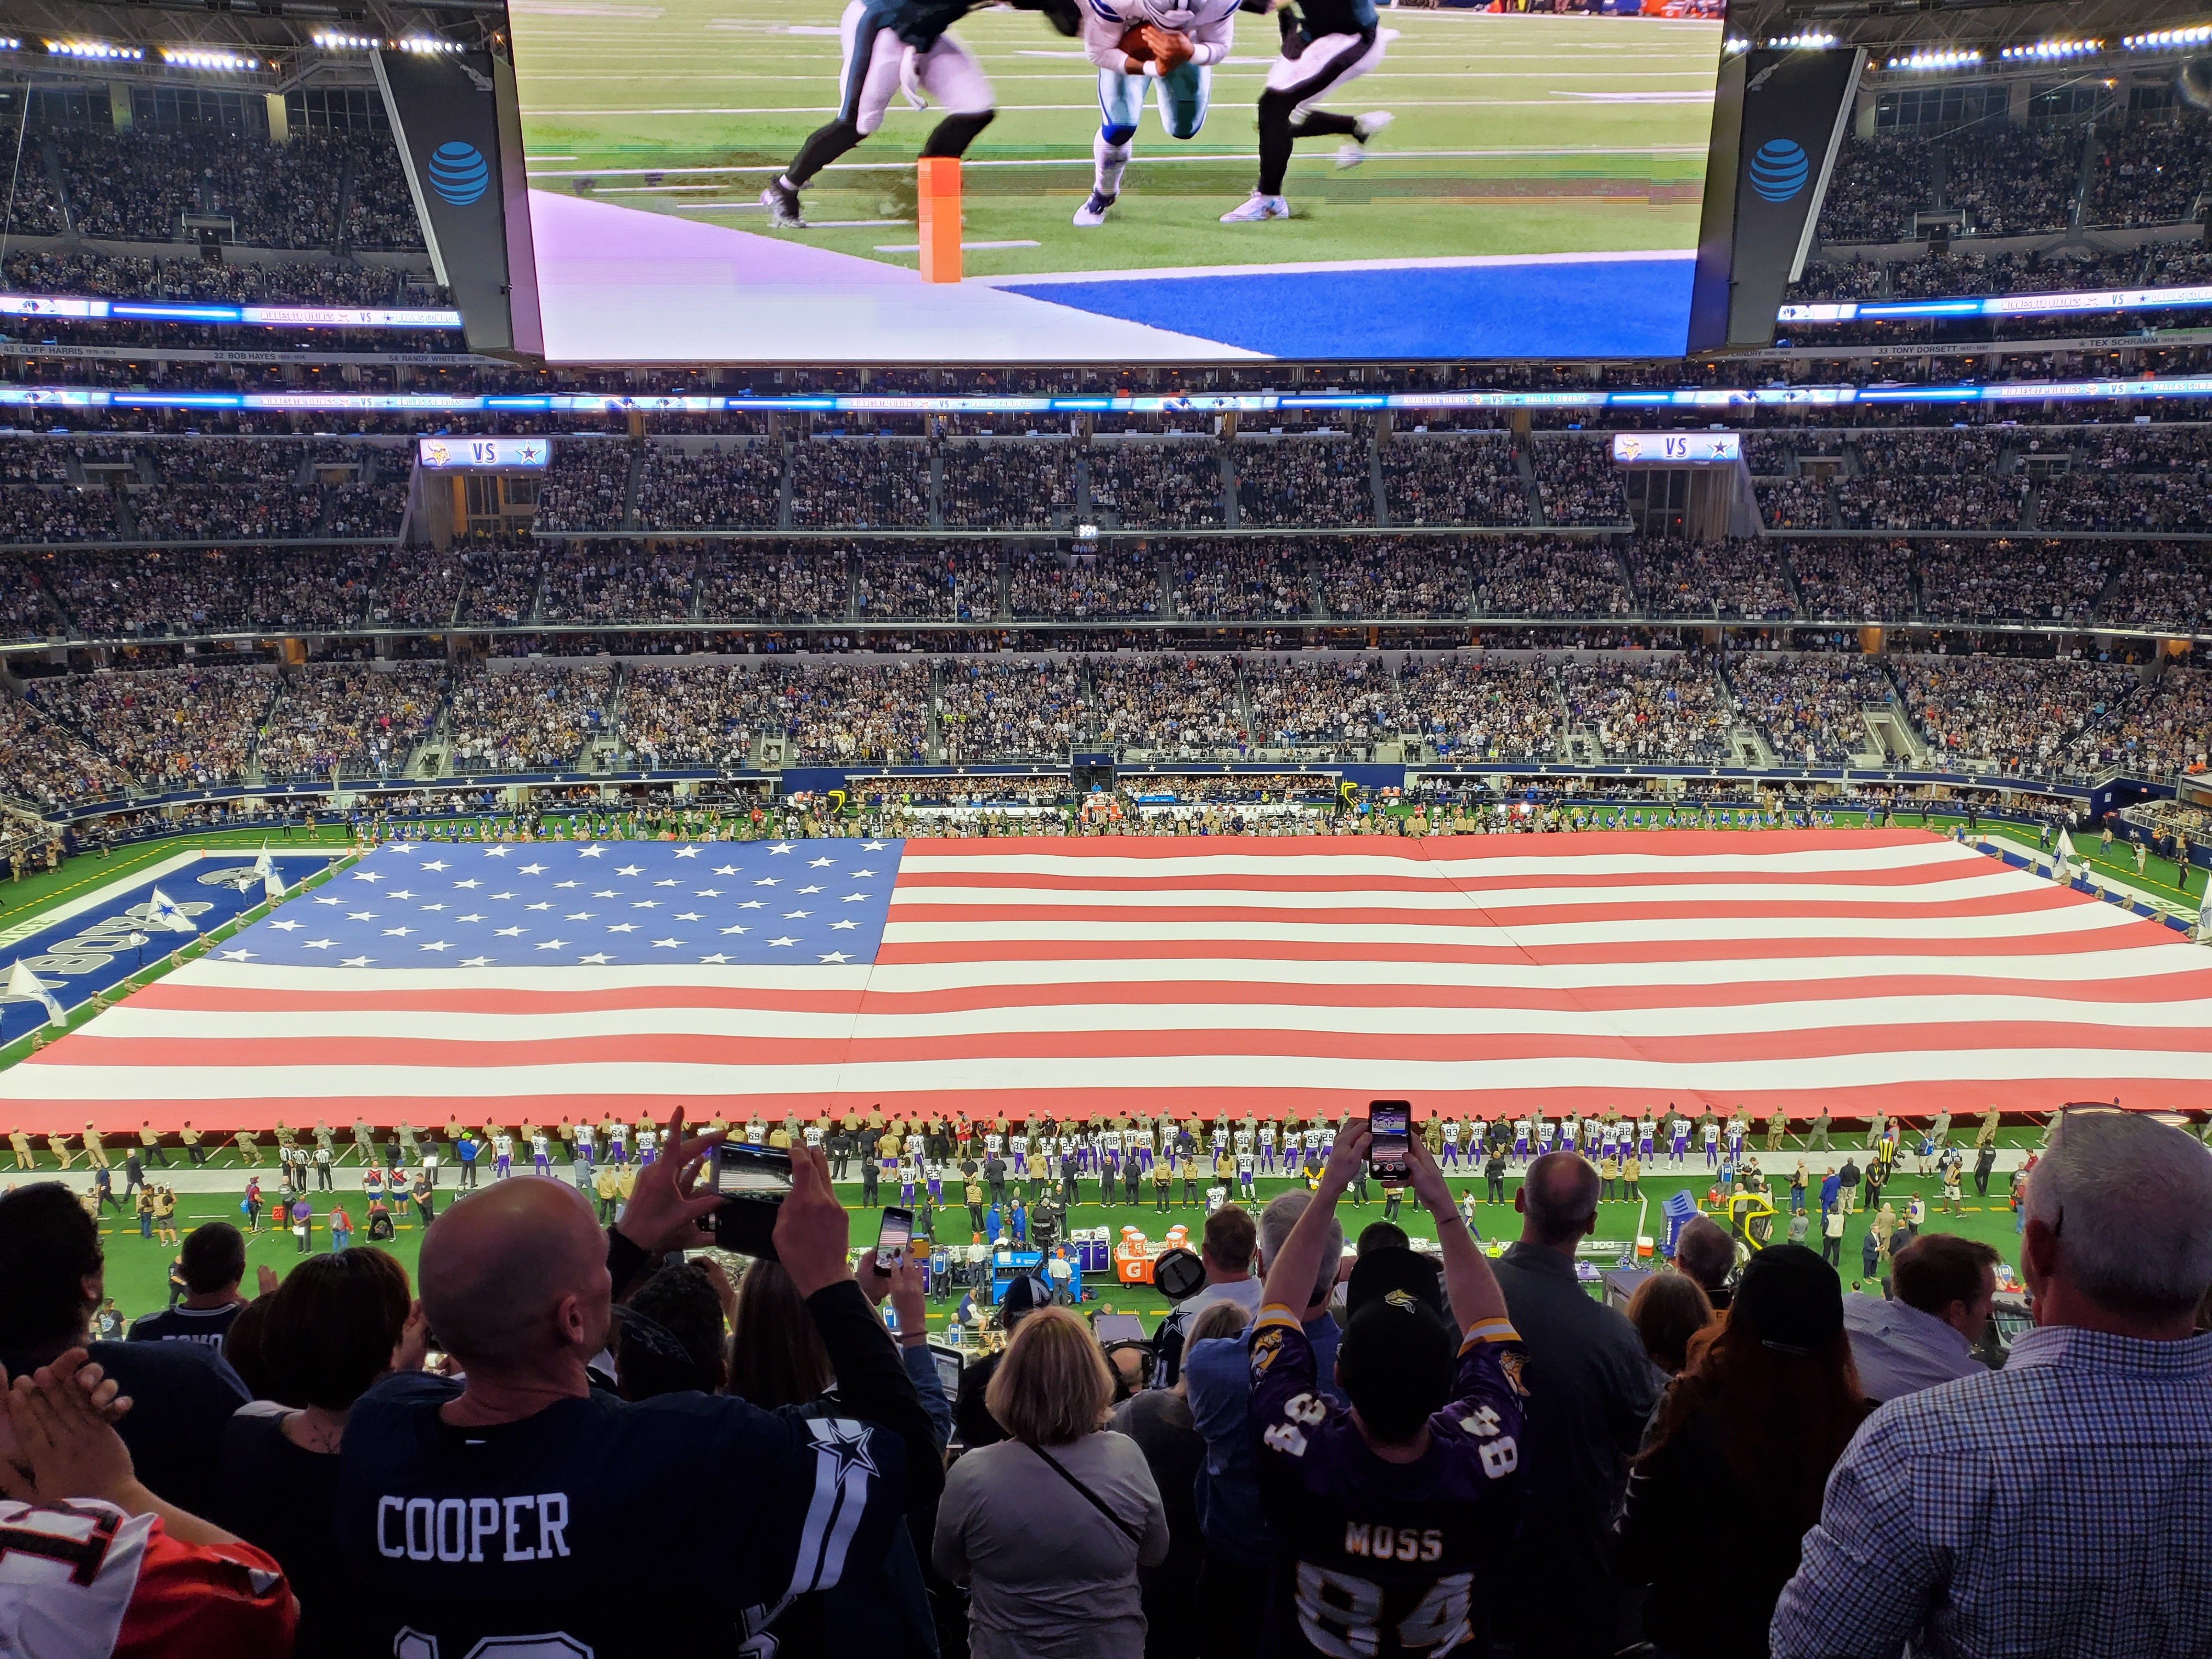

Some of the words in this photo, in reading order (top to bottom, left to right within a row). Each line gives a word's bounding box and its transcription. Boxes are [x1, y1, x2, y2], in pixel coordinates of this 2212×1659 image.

[2002, 298, 2046, 310] MINNESOTA
[2049, 297, 2080, 308] VIKINGS
[2112, 294, 2124, 304] VS
[2152, 290, 2185, 302] DALLAS
[261, 311, 302, 321] MINNESOTA
[304, 312, 334, 321] VIKINGS
[360, 313, 371, 322] VS
[396, 314, 424, 323] DALLAS
[2111, 337, 2158, 346] SCHRAMM
[2001, 387, 2045, 396] MINNESOTA
[2049, 386, 2080, 394] VIKINGS
[2111, 384, 2125, 393] VS
[2152, 382, 2185, 391] DALLAS
[262, 397, 303, 405] MINNESOTA
[306, 398, 334, 406] VIKINGS
[360, 398, 372, 406] VS
[939, 400, 950, 408] VS
[1492, 396, 1503, 404] VS
[1666, 437, 1688, 458] VS
[471, 442, 496, 463] VS
[1447, 1128, 1458, 1137] 93
[1541, 1128, 1552, 1136] 96
[1567, 1127, 1575, 1136] 11
[1587, 1125, 1595, 1133] 51
[1677, 1126, 1687, 1134] 91
[1166, 1132, 1177, 1140] 82
[1218, 1135, 1226, 1143] 16
[1323, 1133, 1333, 1142] 29
[1606, 1131, 1617, 1139] 94
[909, 1141, 919, 1149] 84
[1107, 1137, 1118, 1145] 38
[1015, 1142, 1025, 1150] 30
[903, 1173, 913, 1181] 31
[928, 1169, 939, 1178] 23
[1211, 1194, 1222, 1203] 27
[1126, 1262, 1141, 1278] G
[1263, 1393, 1327, 1458] 84
[1459, 1405, 1518, 1480] 84
[377, 1492, 571, 1562] COOPER
[1345, 1521, 1443, 1562] MOSS
[1295, 1560, 1475, 1659] 84
